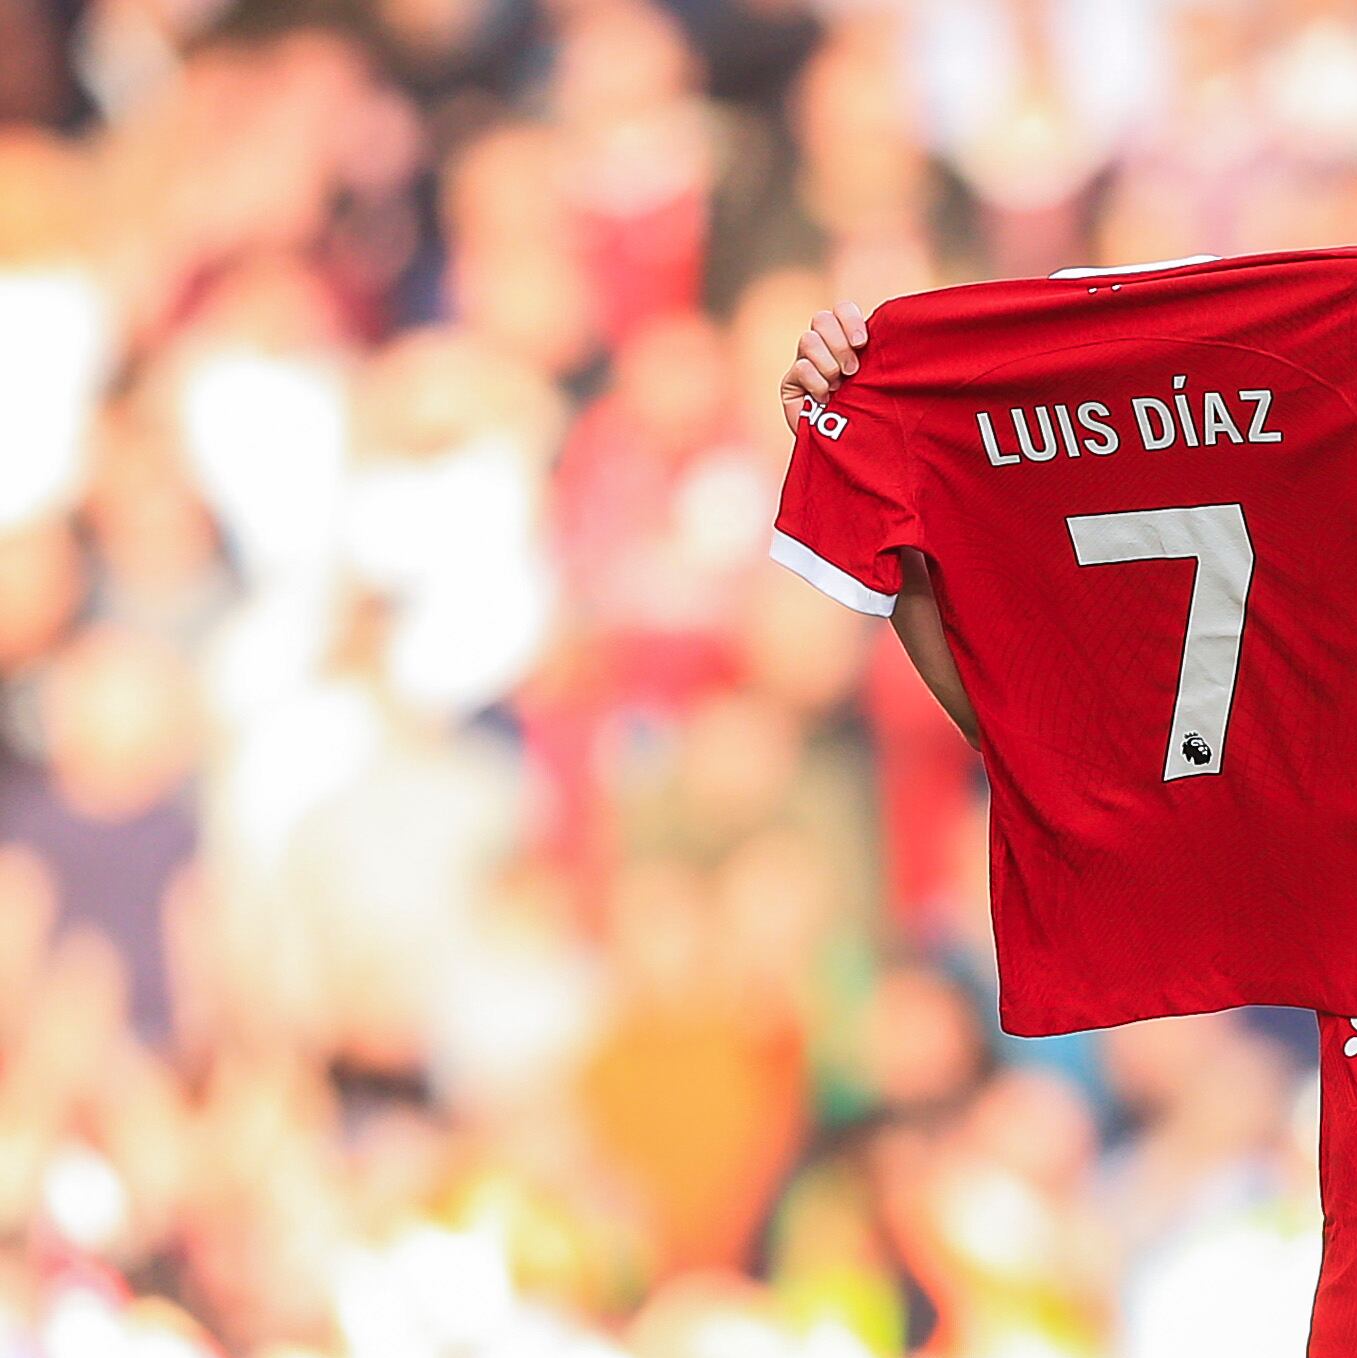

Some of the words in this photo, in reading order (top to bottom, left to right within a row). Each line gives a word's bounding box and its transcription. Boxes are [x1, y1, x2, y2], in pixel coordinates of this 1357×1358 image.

[976, 401, 1119, 466] LUIS
[1132, 375, 1282, 450] DÍAZ
[1064, 502, 1254, 782] 7
